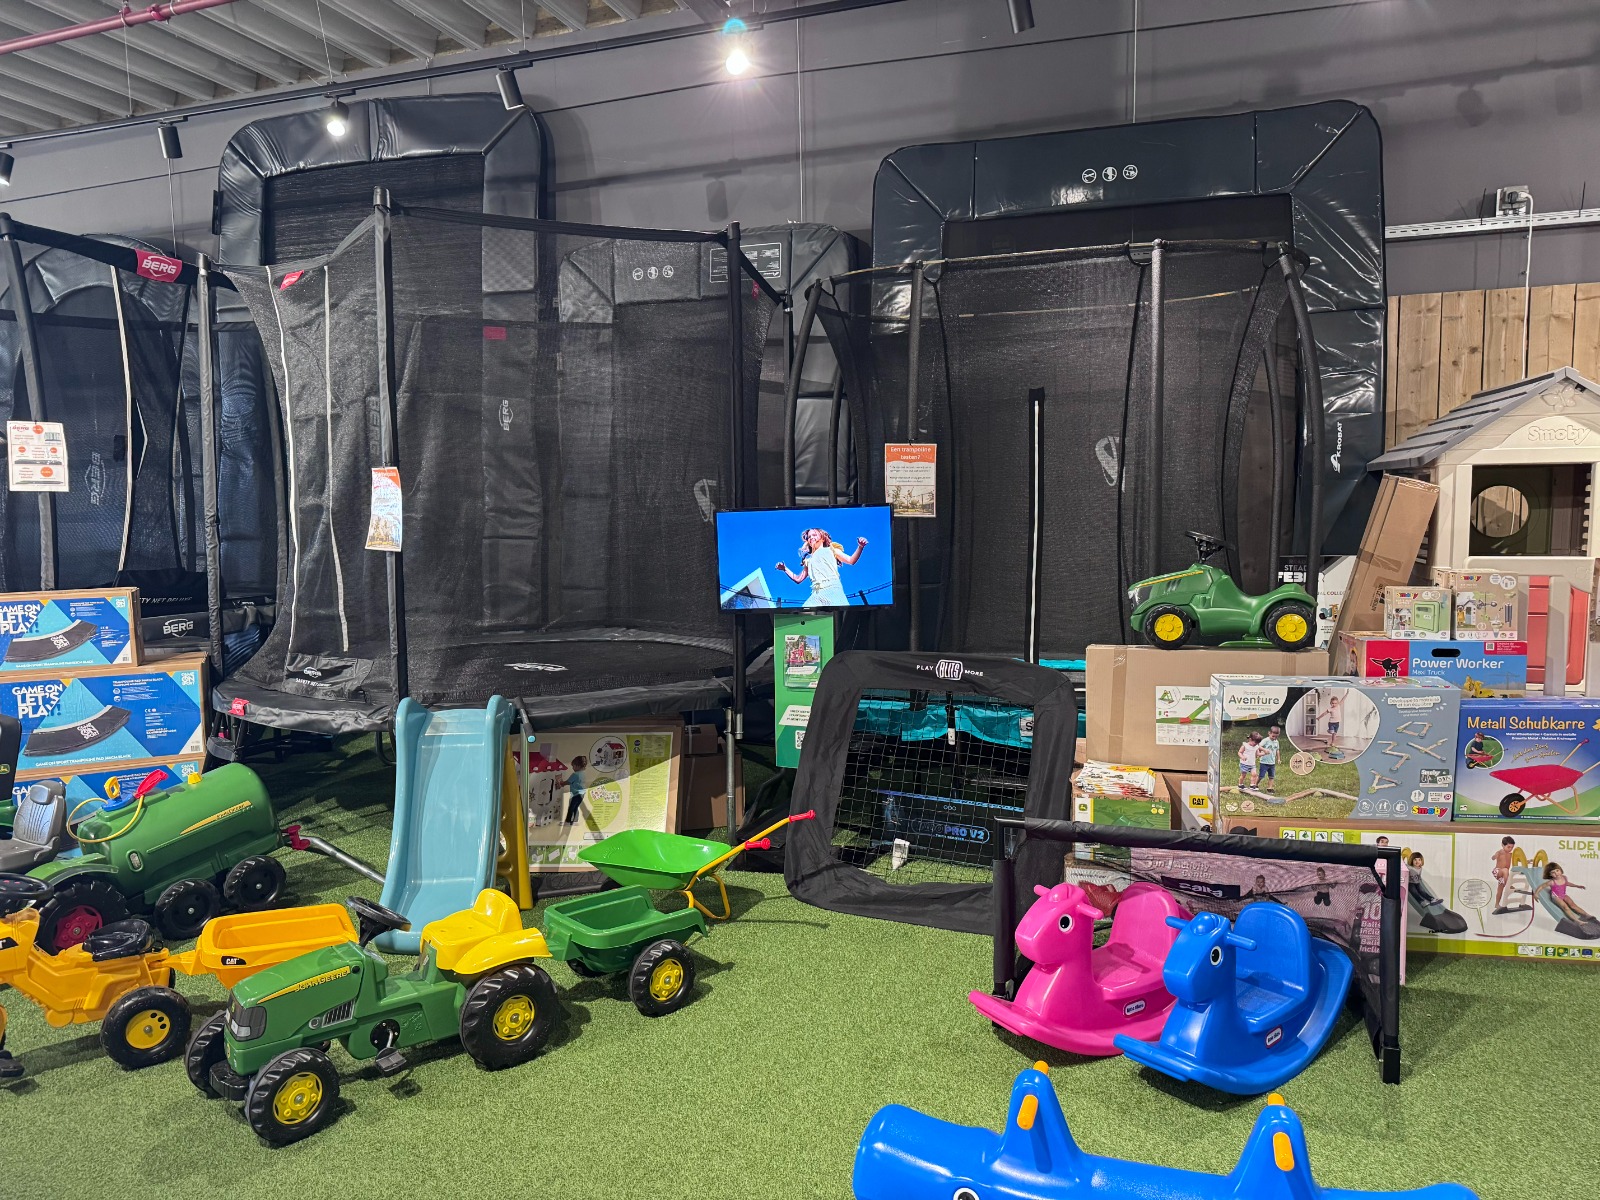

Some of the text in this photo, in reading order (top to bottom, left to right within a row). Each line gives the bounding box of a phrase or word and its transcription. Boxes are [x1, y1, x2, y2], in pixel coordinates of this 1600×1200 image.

[142, 259, 177, 275] BERG
[1528, 425, 1591, 445] Smoby
[24, 604, 41, 612] ON
[2, 611, 37, 623] LET'S
[163, 620, 194, 635] BERG
[939, 661, 961, 679] BLITS
[964, 669, 984, 677] MORE
[1412, 658, 1504, 669] Power Worker
[12, 684, 63, 695] GAME ON
[17, 692, 60, 707] LET'S
[1228, 694, 1280, 705] Aventure
[1467, 716, 1586, 730] Metall Schubkarre
[1192, 797, 1205, 806] CAT
[1411, 804, 1449, 818] Smoby
[944, 825, 968, 837] PRO
[969, 829, 985, 840] V2
[1283, 832, 1295, 840] 2+
[1558, 839, 1595, 851] SLIDE
[1179, 882, 1223, 898] salta
[295, 970, 348, 992] JOHN DEERE
